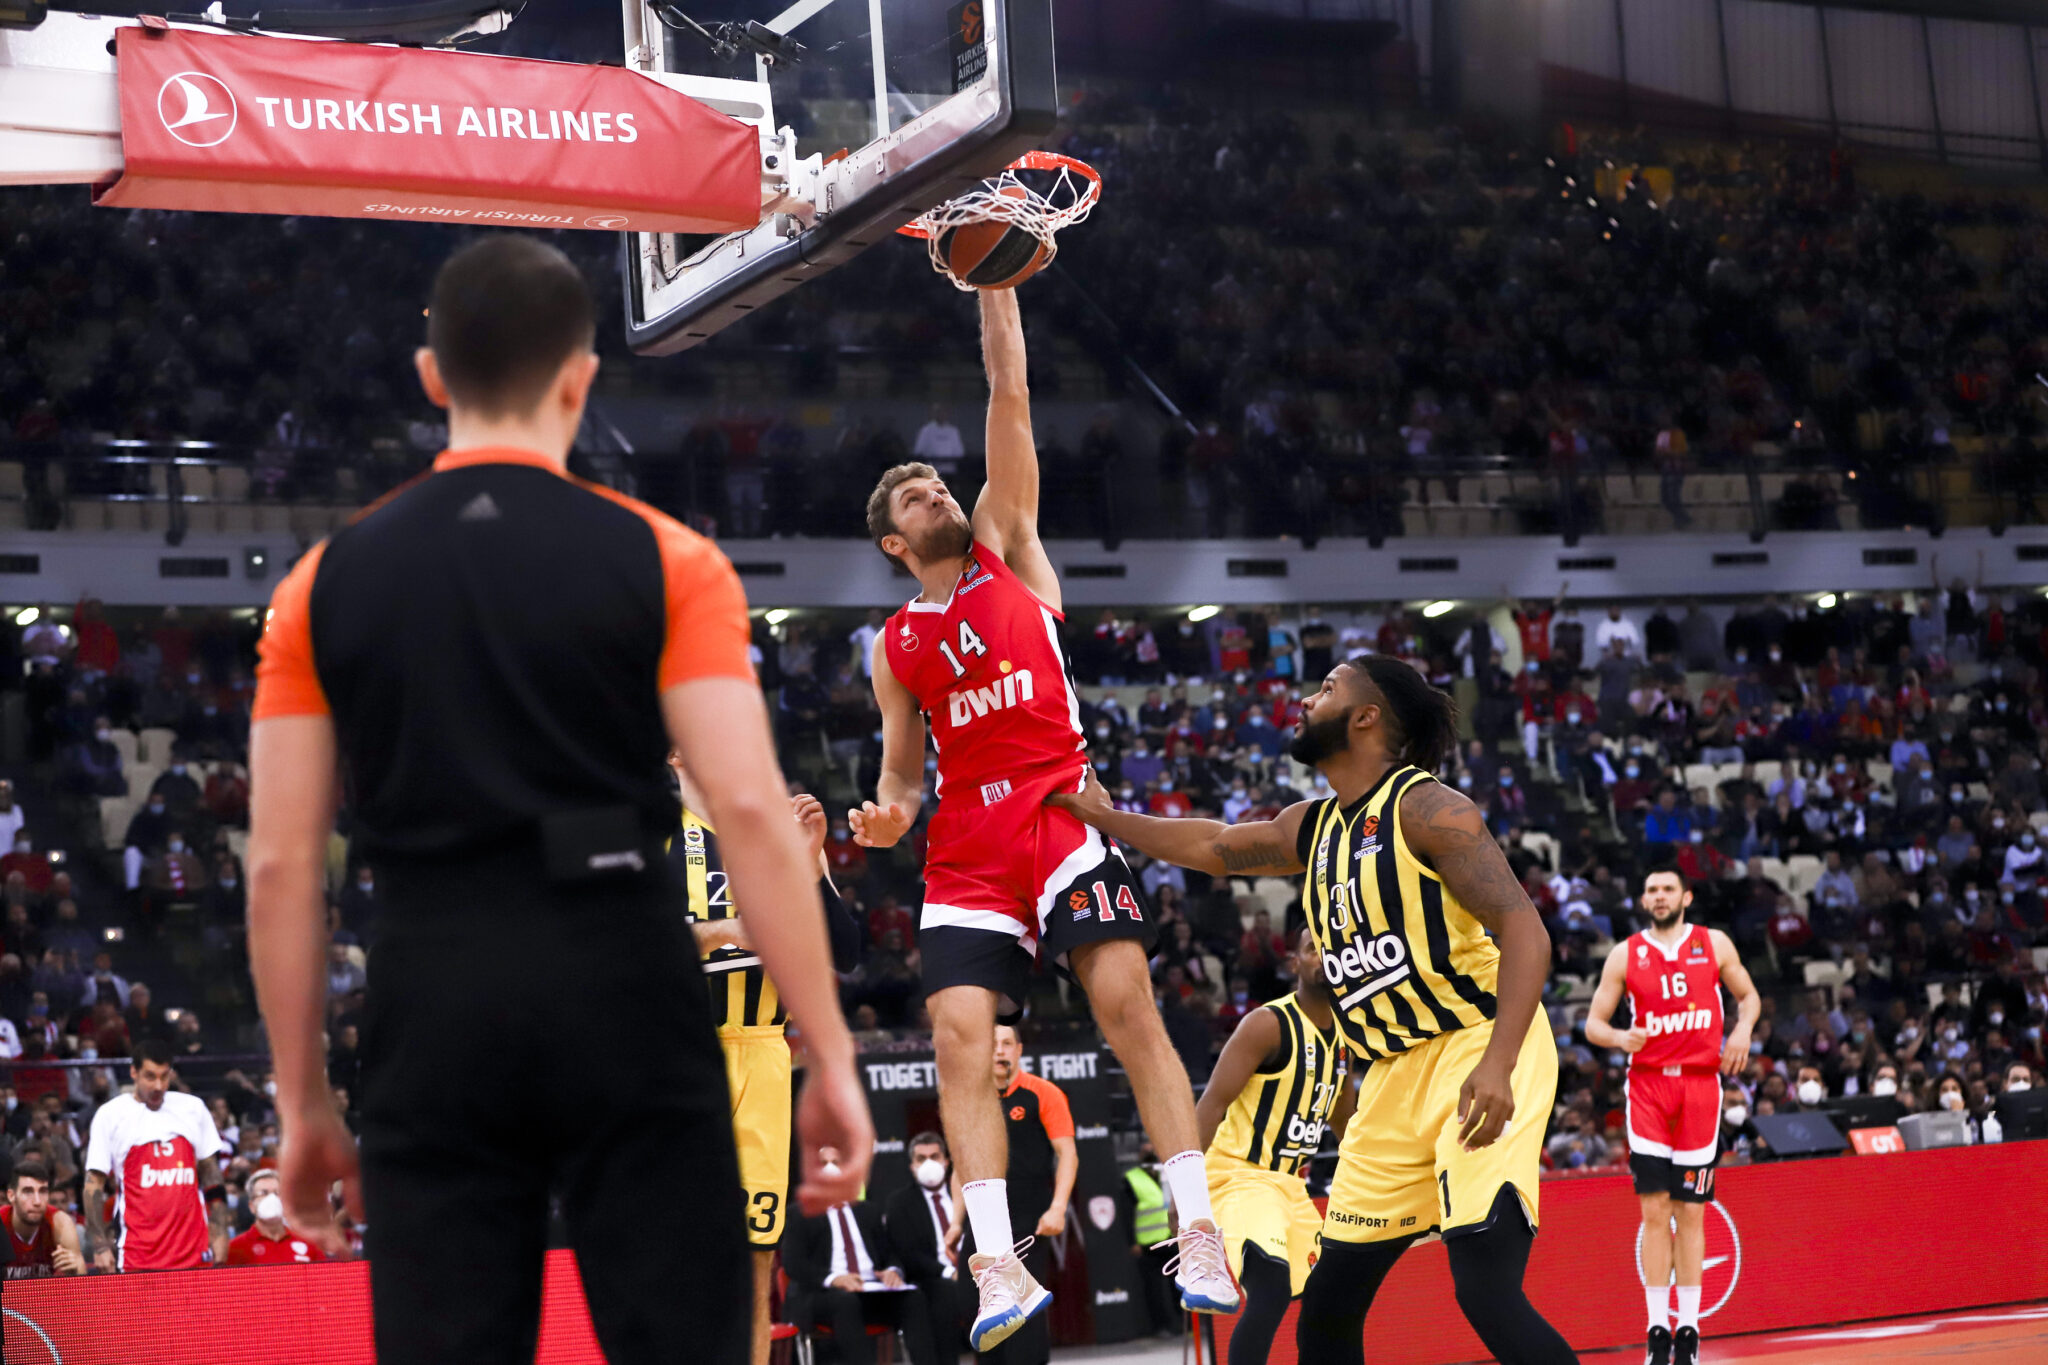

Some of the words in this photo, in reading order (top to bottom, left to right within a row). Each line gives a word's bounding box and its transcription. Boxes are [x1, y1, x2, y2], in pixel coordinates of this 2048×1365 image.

[957, 42, 985, 67] TURKIS
[958, 55, 987, 80] AIRLINE
[255, 97, 442, 135] TURKISH
[457, 106, 638, 143] AIRLINES
[363, 203, 470, 217] AIRLINES
[474, 209, 575, 224] TURKISH
[938, 618, 988, 678] 14
[949, 660, 1033, 727] bwin
[986, 782, 1006, 801] OLY
[706, 871, 733, 906] 2
[1092, 881, 1143, 922] 14
[1330, 878, 1363, 930] 31
[1322, 934, 1405, 985] beko
[1660, 972, 1688, 999] 16
[1645, 1002, 1712, 1037] bwin
[866, 1062, 938, 1091] TOGET
[1041, 1053, 1098, 1080] FIGHT
[1311, 1082, 1336, 1114] 21
[1287, 1114, 1325, 1144] bek
[140, 1161, 195, 1188] bwin
